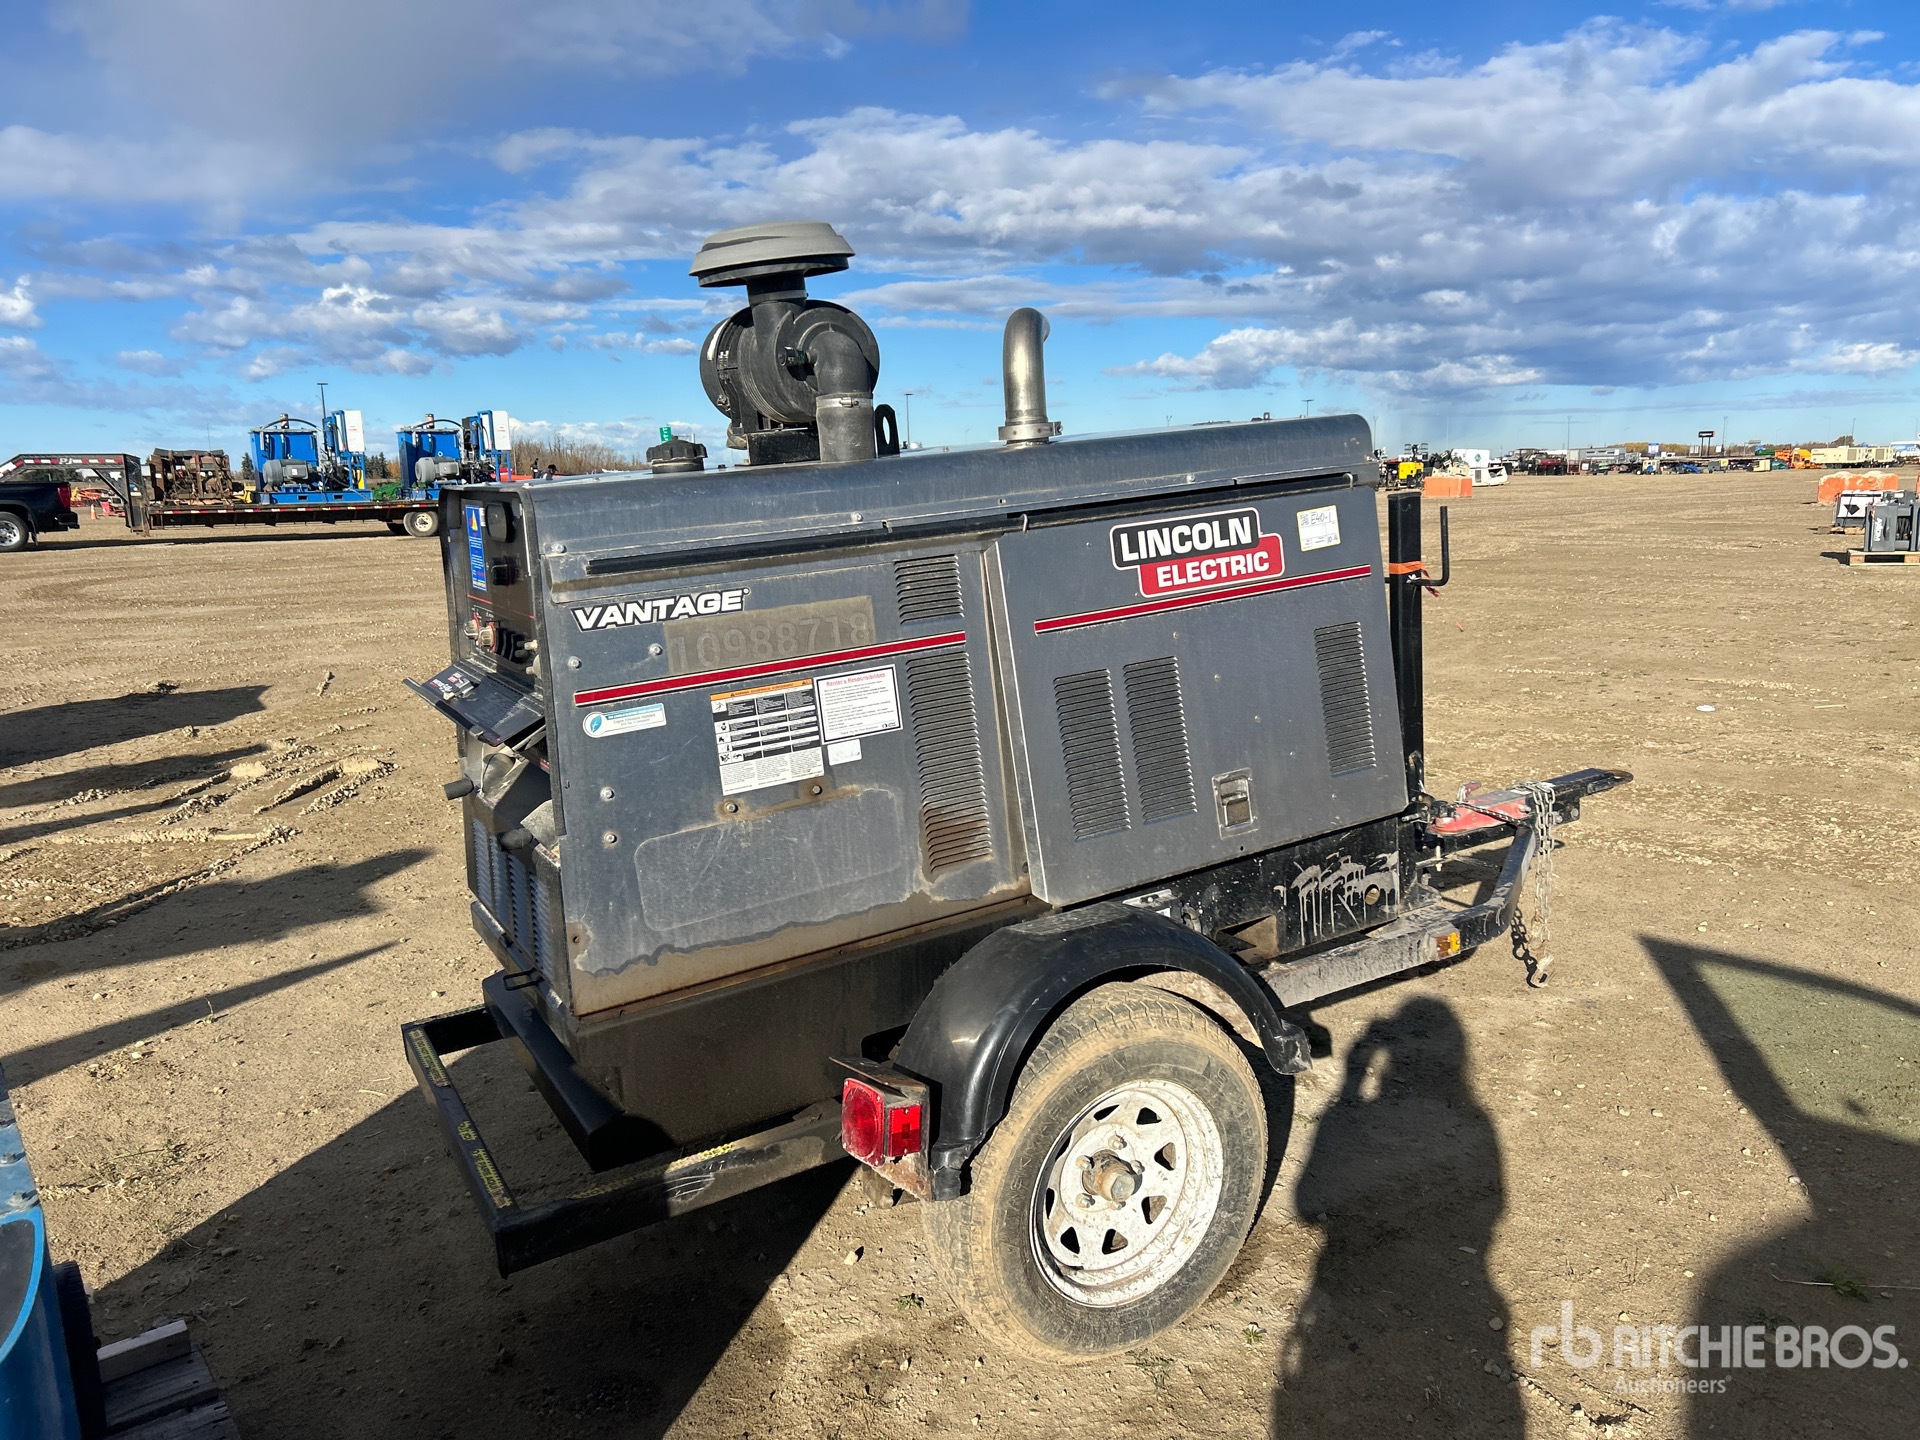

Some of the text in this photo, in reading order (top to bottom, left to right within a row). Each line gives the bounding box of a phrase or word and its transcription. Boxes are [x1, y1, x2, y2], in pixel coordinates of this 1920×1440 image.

[1120, 516, 1252, 562] LINCOLN
[1156, 551, 1270, 588] ELECTRIC
[573, 589, 745, 630] VANTAGE
[847, 672, 886, 683] Responsibilities
